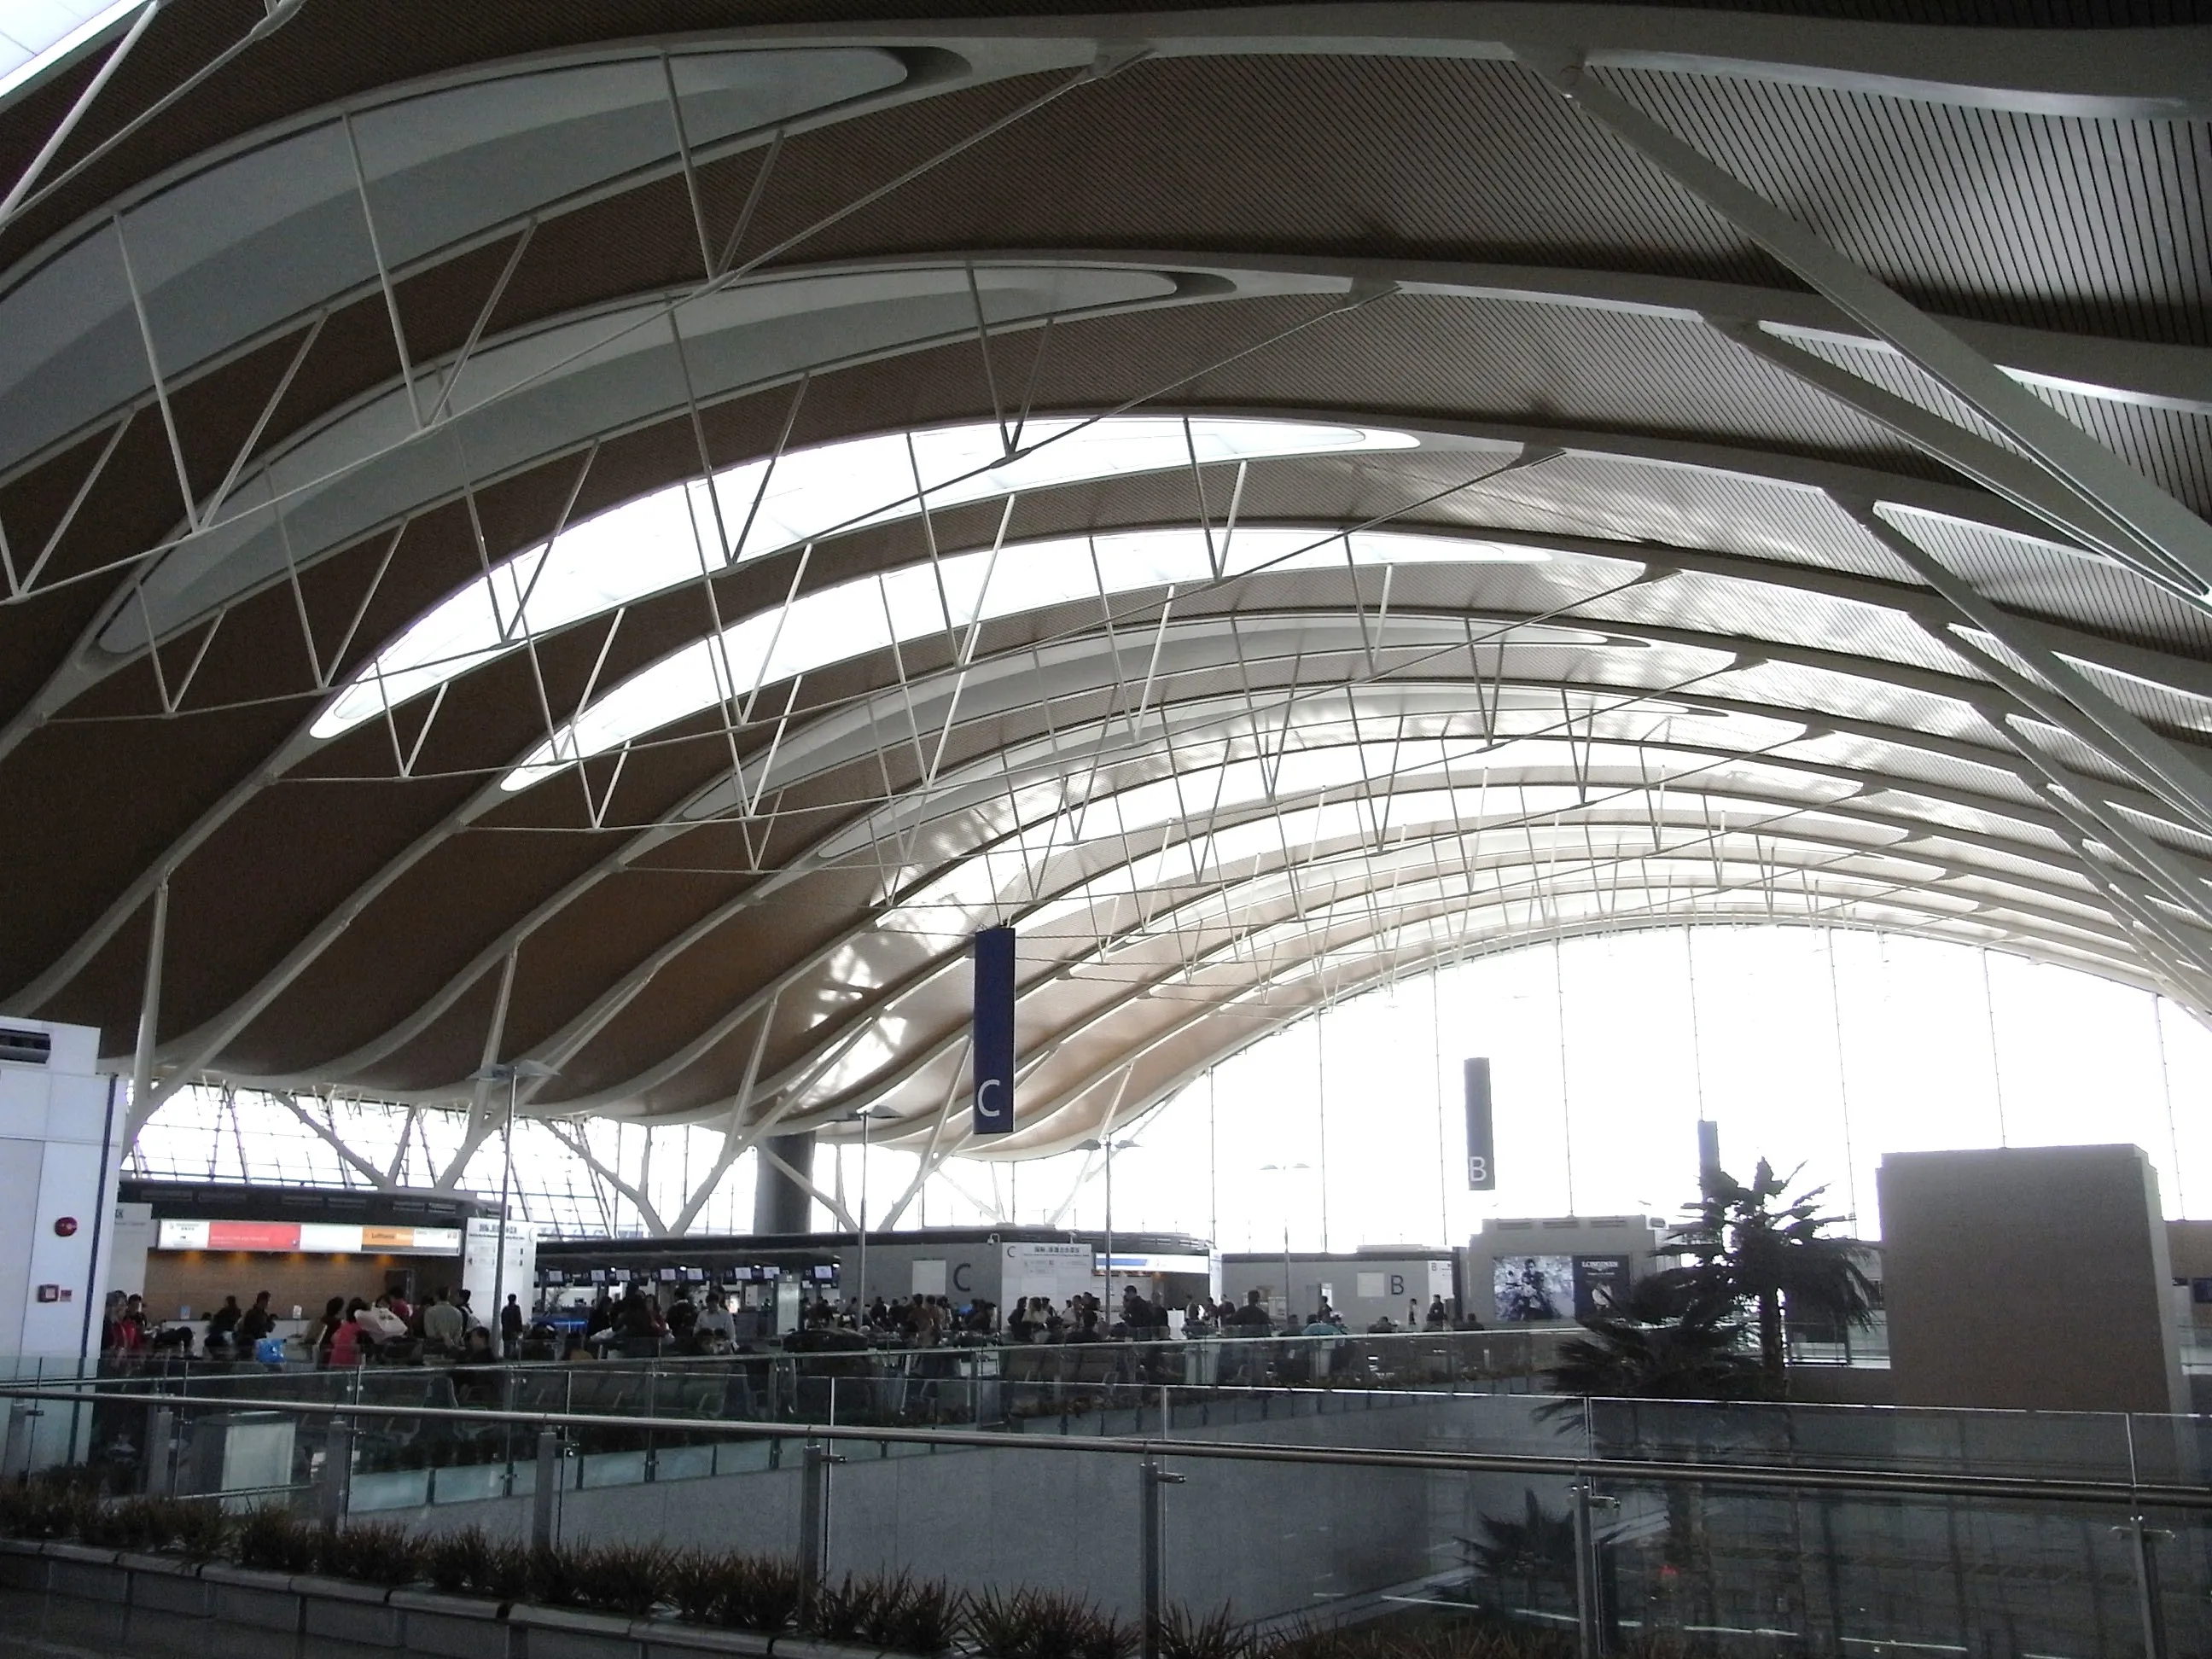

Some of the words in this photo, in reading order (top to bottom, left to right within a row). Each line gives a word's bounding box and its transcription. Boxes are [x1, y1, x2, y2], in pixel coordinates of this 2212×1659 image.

[977, 1079, 1000, 1117] C
[1469, 1156, 1487, 1182] B
[1007, 1246, 1016, 1258] C
[952, 1263, 971, 1292] C
[1390, 1274, 1404, 1295] B
